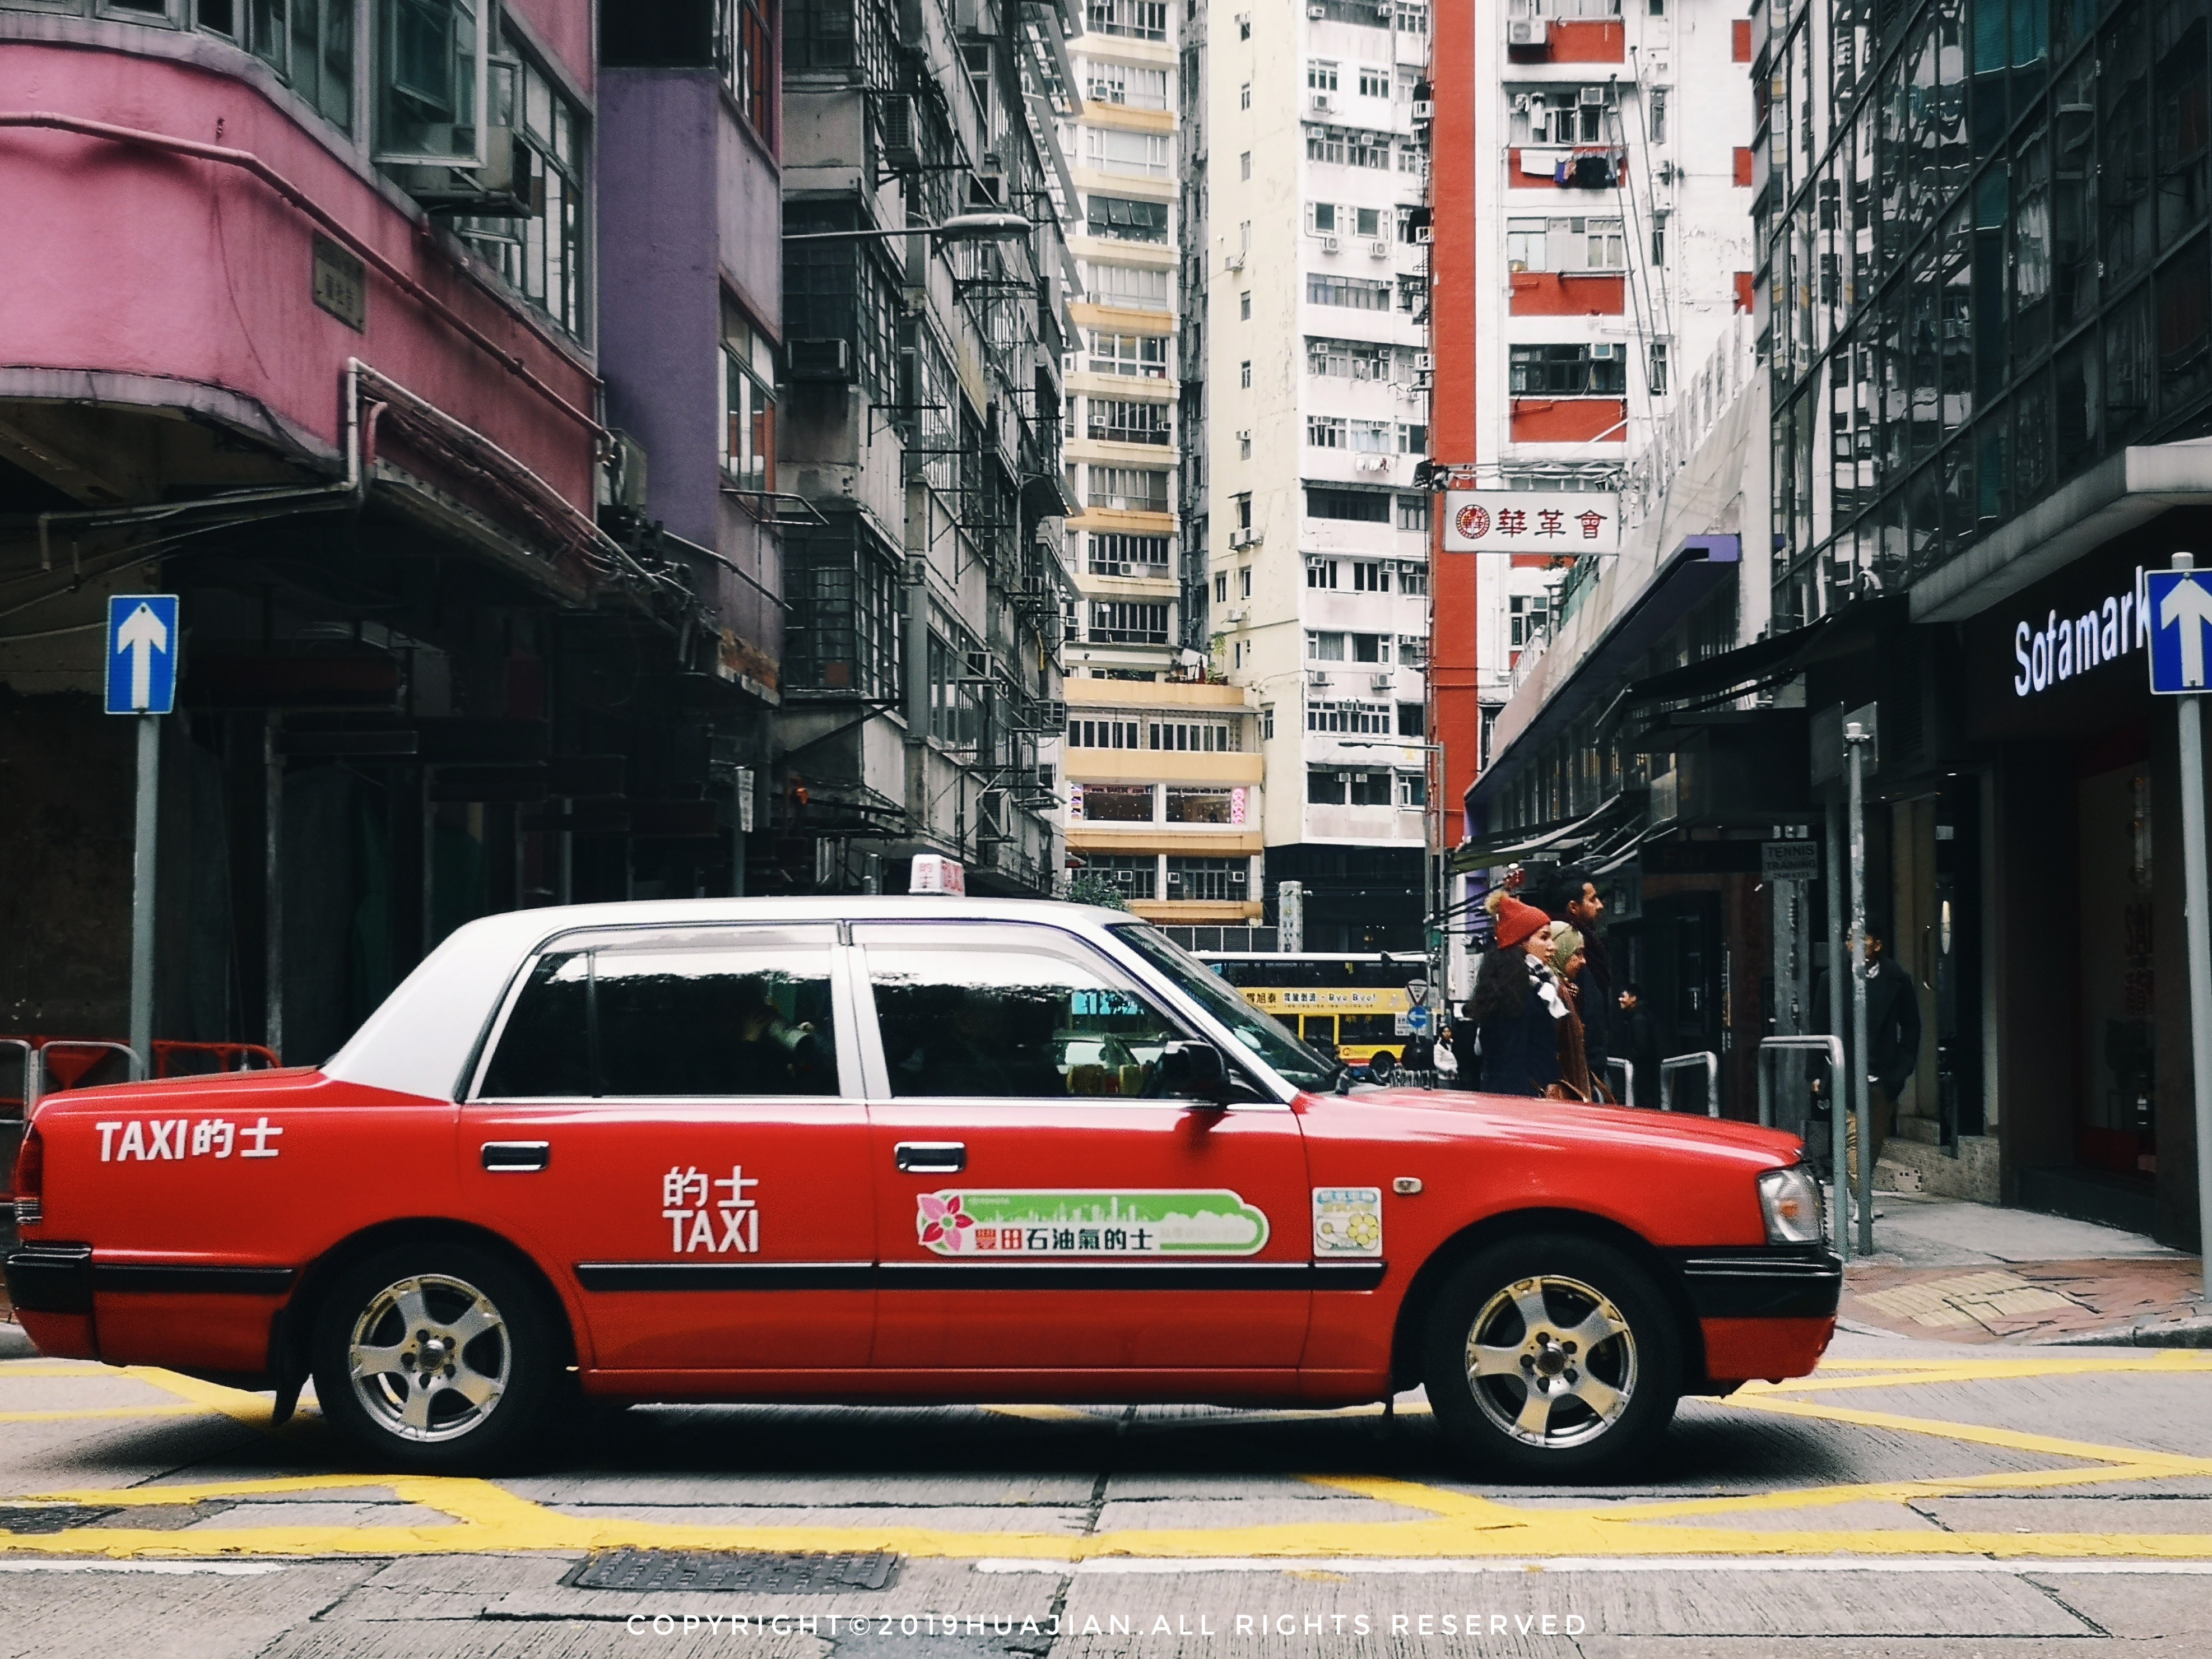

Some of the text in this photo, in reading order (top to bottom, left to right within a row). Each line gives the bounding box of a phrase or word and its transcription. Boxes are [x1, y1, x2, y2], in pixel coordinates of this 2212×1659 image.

[1495, 508, 1607, 539] 華革會
[2014, 565, 2150, 697] Sofamark
[1765, 859, 1816, 870] TRAINING
[1766, 844, 1814, 857] TENNIS
[663, 1165, 759, 1207] 的士
[662, 1209, 759, 1253] TAXI
